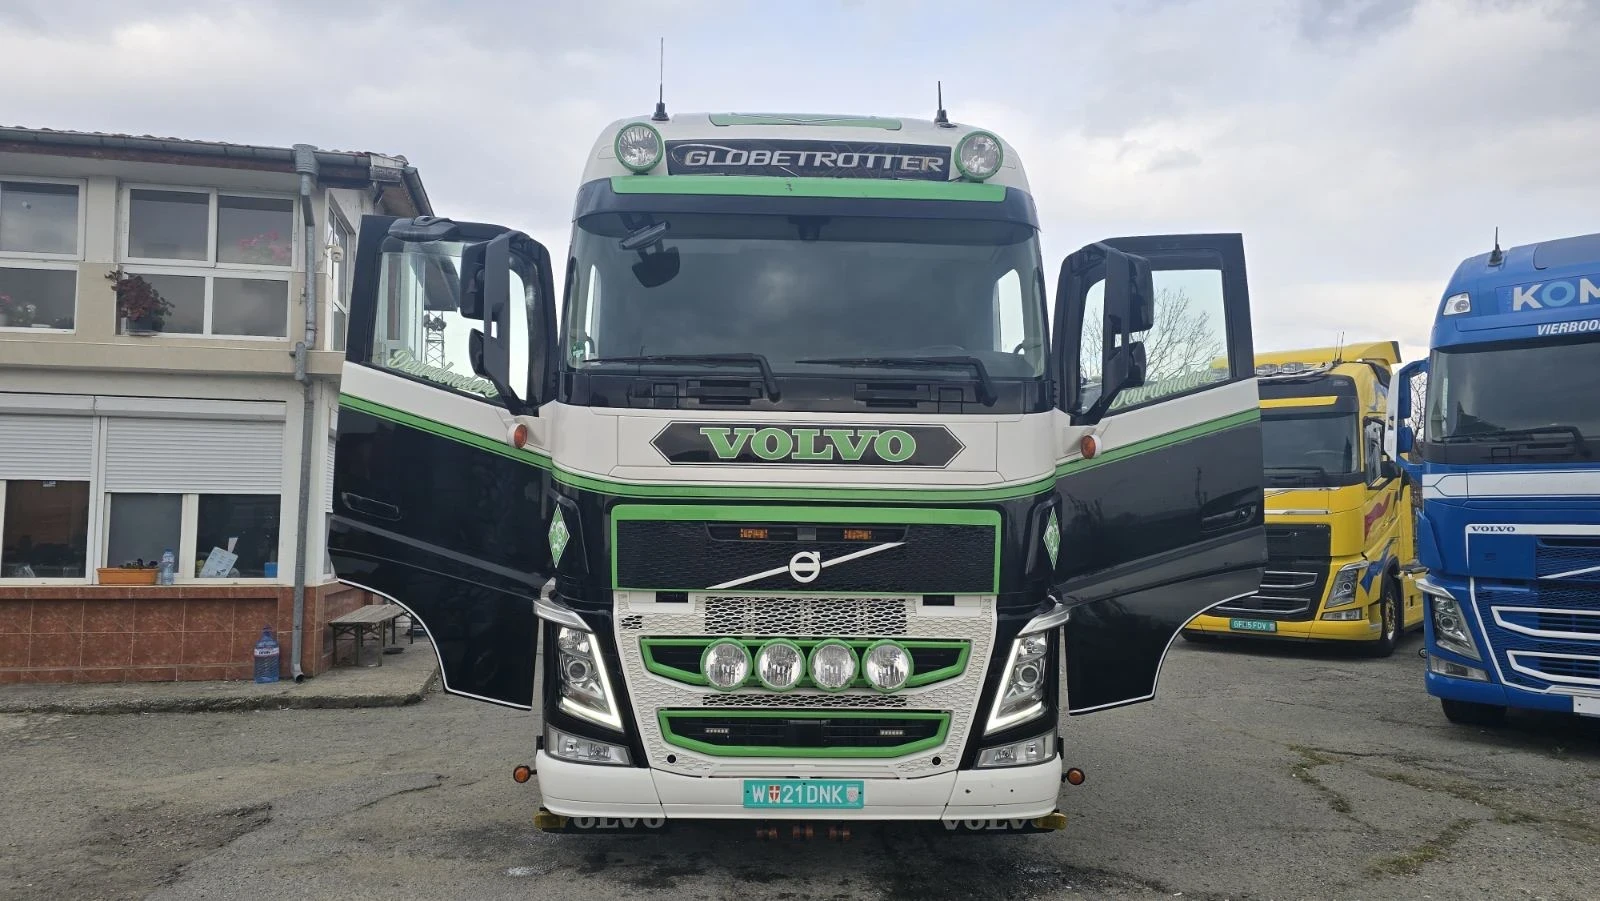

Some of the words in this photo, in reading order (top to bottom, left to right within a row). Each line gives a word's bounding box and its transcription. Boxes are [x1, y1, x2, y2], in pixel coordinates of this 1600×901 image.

[684, 150, 944, 172] GLOBETROTTER
[1537, 319, 1600, 336] VIERBOO
[699, 427, 917, 463] VOLVO
